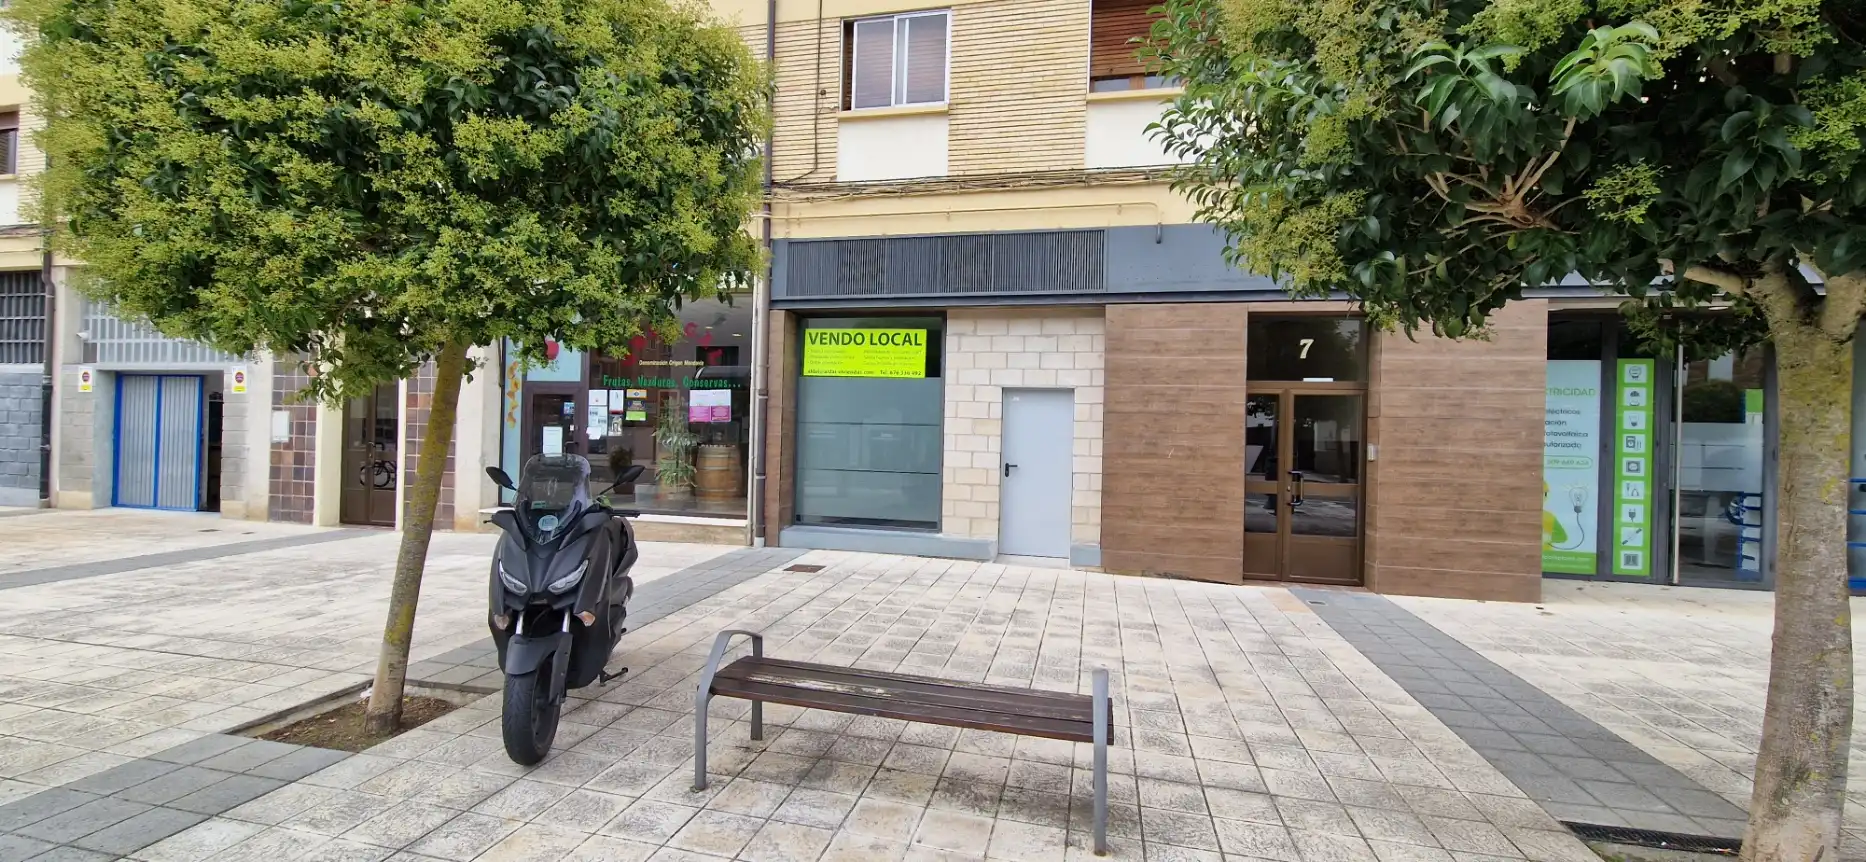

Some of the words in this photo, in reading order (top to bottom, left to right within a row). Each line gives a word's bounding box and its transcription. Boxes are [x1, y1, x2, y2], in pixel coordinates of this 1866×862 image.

[808, 332, 865, 346] VENDO
[870, 332, 923, 347] LOCAL
[1299, 338, 1315, 359] 7
